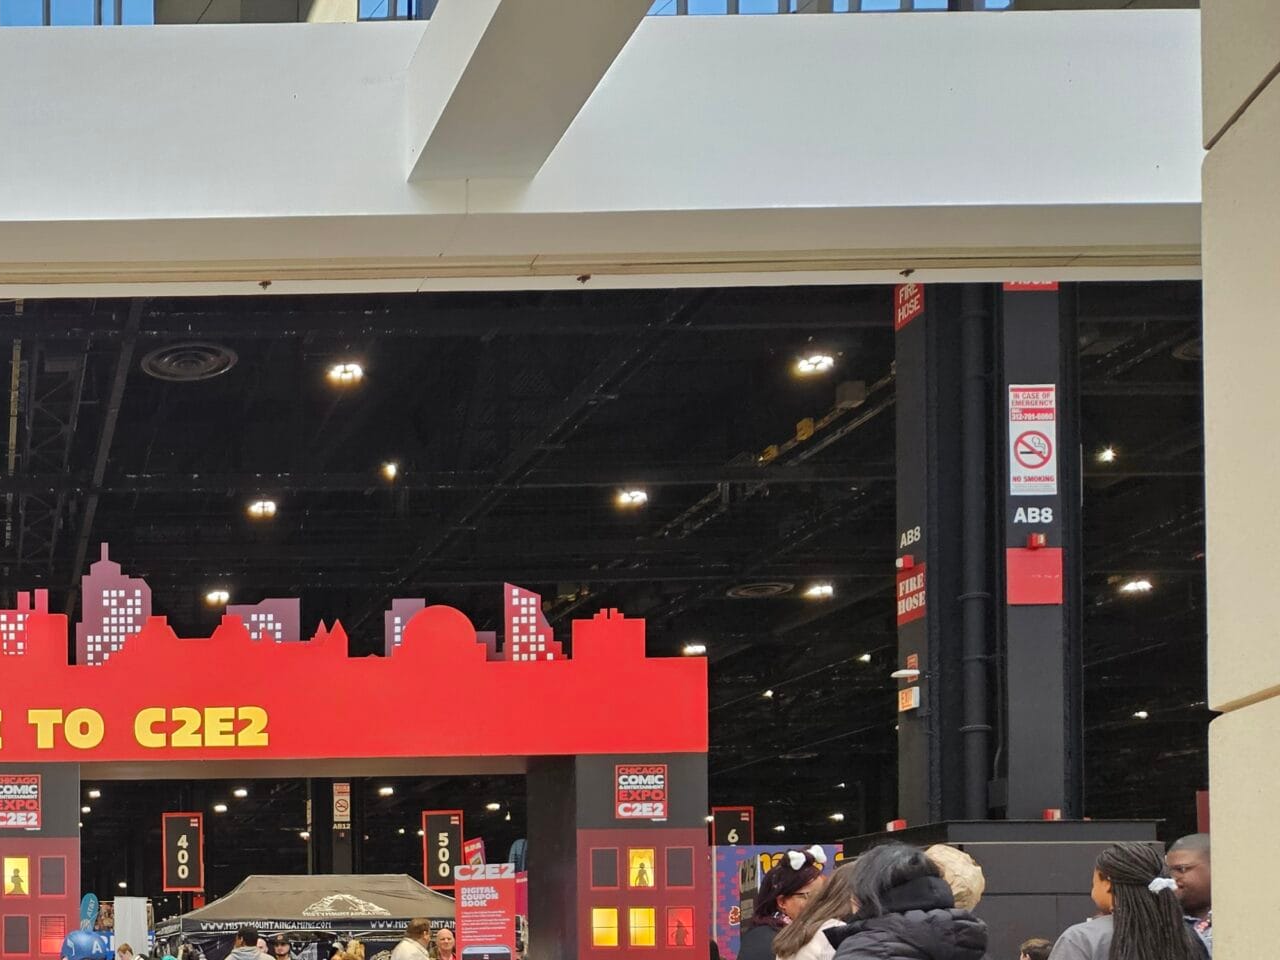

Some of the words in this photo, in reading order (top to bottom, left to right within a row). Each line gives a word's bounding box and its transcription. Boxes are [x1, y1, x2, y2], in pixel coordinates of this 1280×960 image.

[898, 294, 921, 323] HOSE
[1012, 475, 1022, 483] NO
[1023, 475, 1055, 483] SMOKING
[1013, 507, 1054, 524] AB8
[900, 525, 921, 549] AB8
[898, 572, 924, 597] FIRE
[897, 590, 926, 616] HOSE
[27, 707, 105, 750] TO
[133, 706, 269, 748] C2E2
[618, 775, 665, 785] COMIC
[618, 790, 665, 801] EXPO
[618, 802, 665, 817] C2E2
[727, 829, 739, 846] 6
[177, 834, 189, 879] 400
[438, 832, 451, 878] 500
[453, 863, 515, 881] C2E2
[461, 886, 496, 894] DIGITAL
[461, 893, 499, 901] COUPON
[461, 900, 488, 908] BOOK
[91, 940, 103, 954] A
